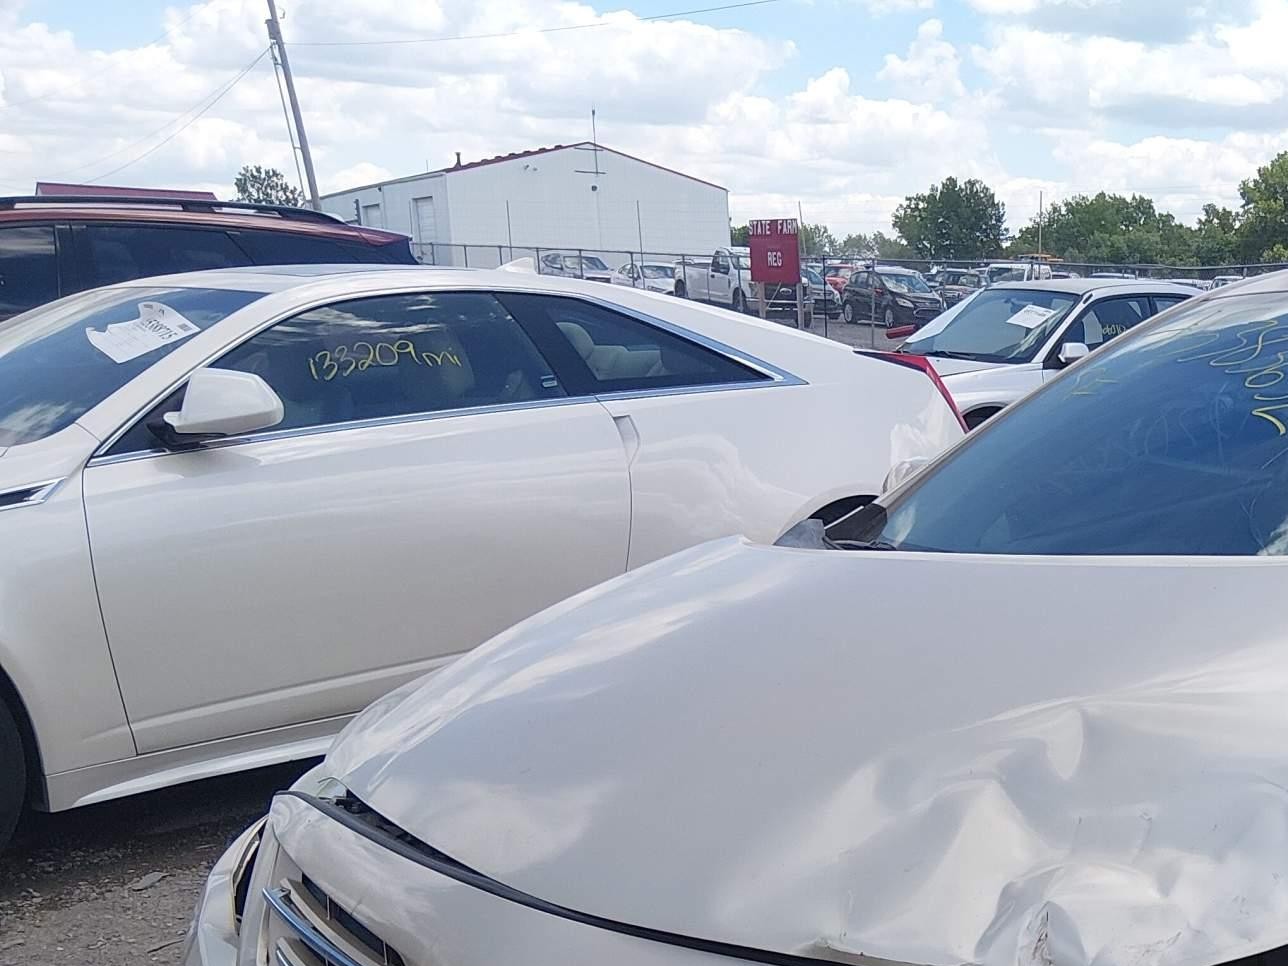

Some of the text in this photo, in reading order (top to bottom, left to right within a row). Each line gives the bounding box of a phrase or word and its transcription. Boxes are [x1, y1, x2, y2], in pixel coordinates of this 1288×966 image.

[748, 219, 798, 236] STATE FARM
[767, 251, 782, 267] REG
[309, 340, 422, 381] 133209
